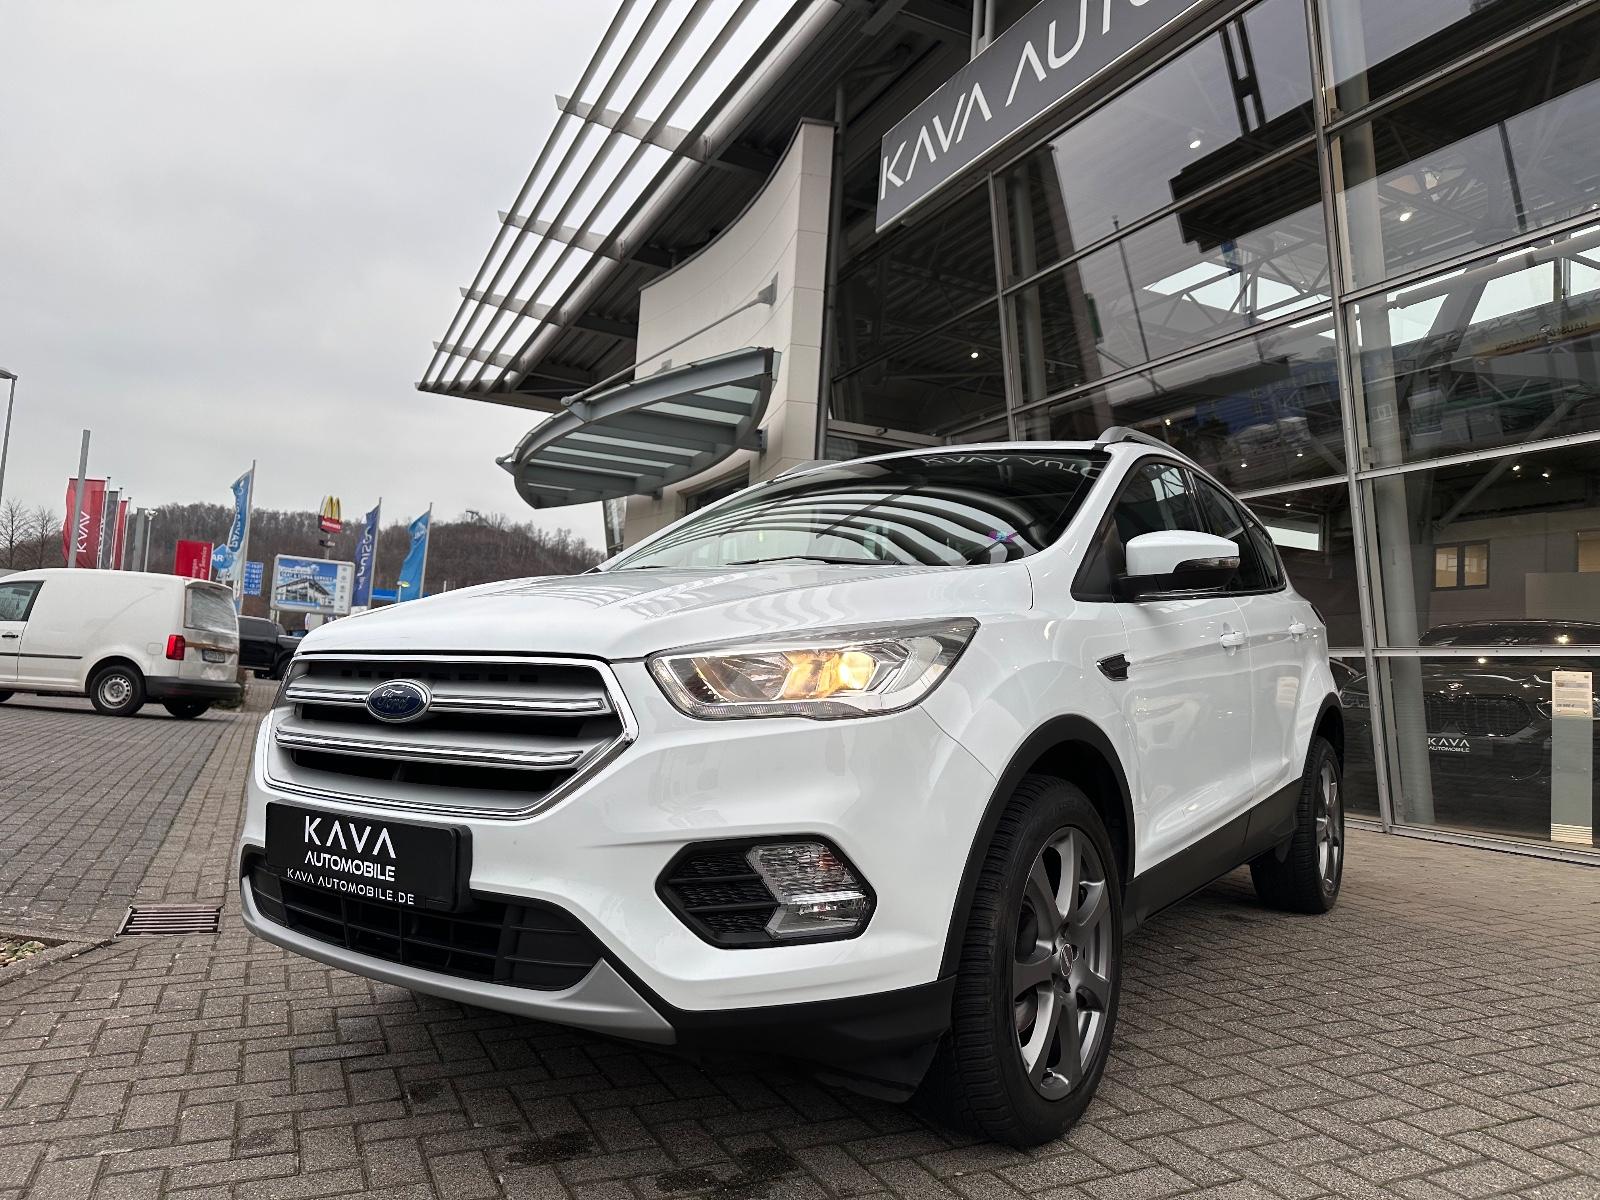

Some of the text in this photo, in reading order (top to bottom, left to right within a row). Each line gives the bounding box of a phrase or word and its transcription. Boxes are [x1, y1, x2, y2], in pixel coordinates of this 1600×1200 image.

[880, 0, 1151, 200] KAVA AU
[1428, 737, 1470, 747] KAVA
[304, 815, 396, 859] KAVA
[304, 850, 396, 882] AUTOMOBILE
[287, 867, 415, 905] KAVA AUTOMOBILE.DE
